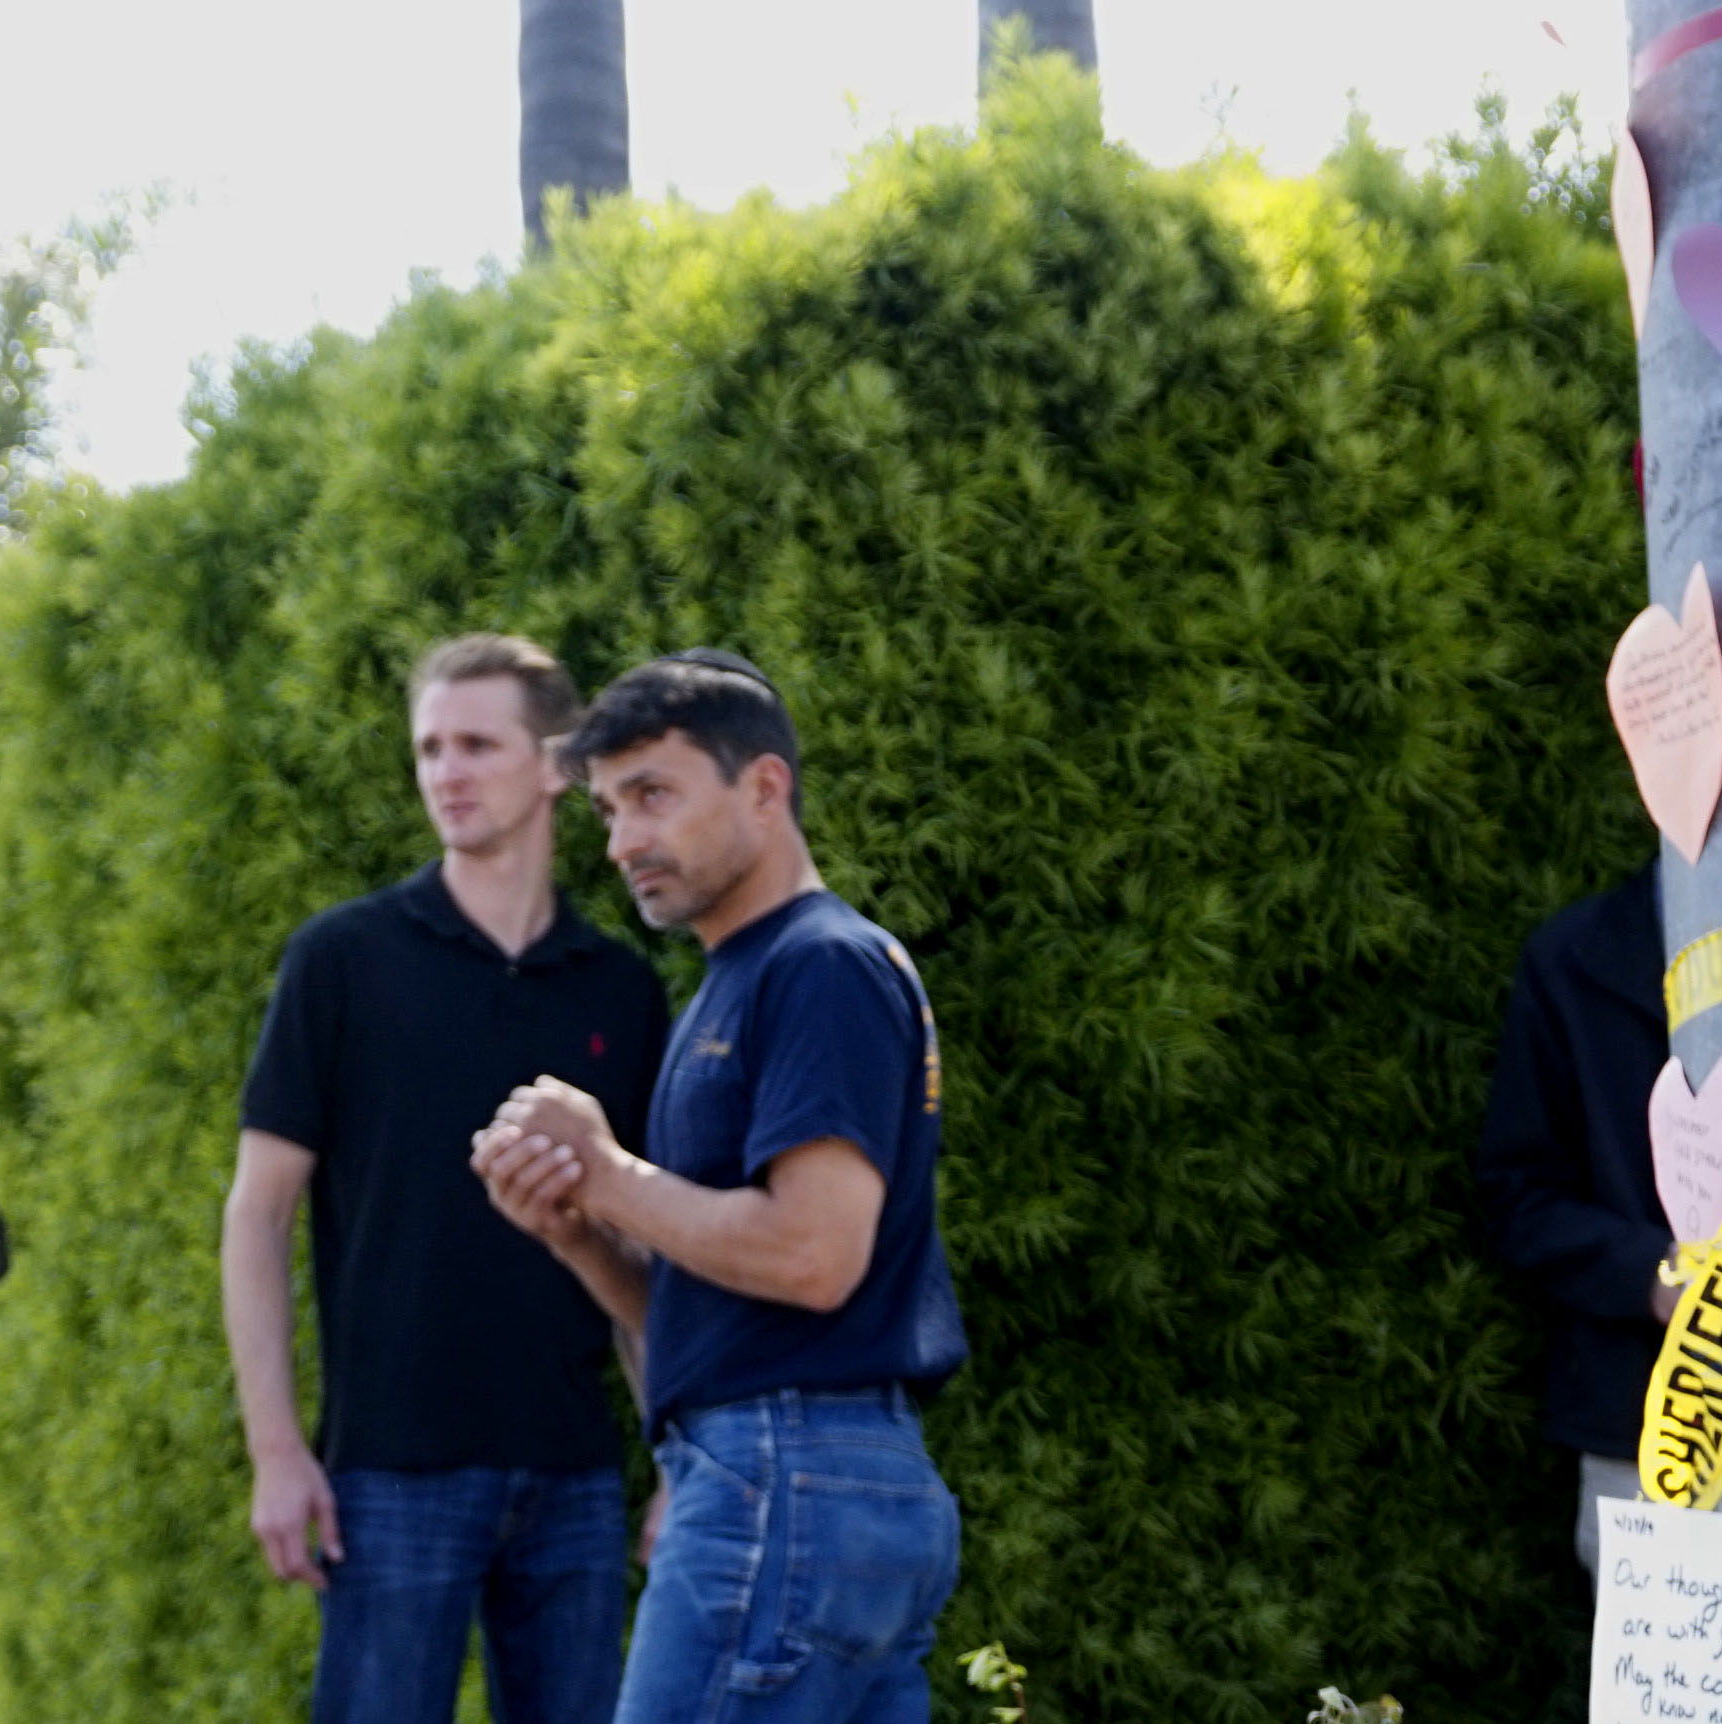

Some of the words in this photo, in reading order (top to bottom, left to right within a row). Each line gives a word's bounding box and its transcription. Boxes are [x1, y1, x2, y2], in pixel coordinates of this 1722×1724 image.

[1614, 1557, 1651, 1589] Our
[1622, 1617, 1653, 1637] are
[1667, 1615, 1709, 1641] with
[1614, 1654, 1654, 1714] May
[1664, 1662, 1690, 1689] the
[1658, 1698, 1697, 1720] know
